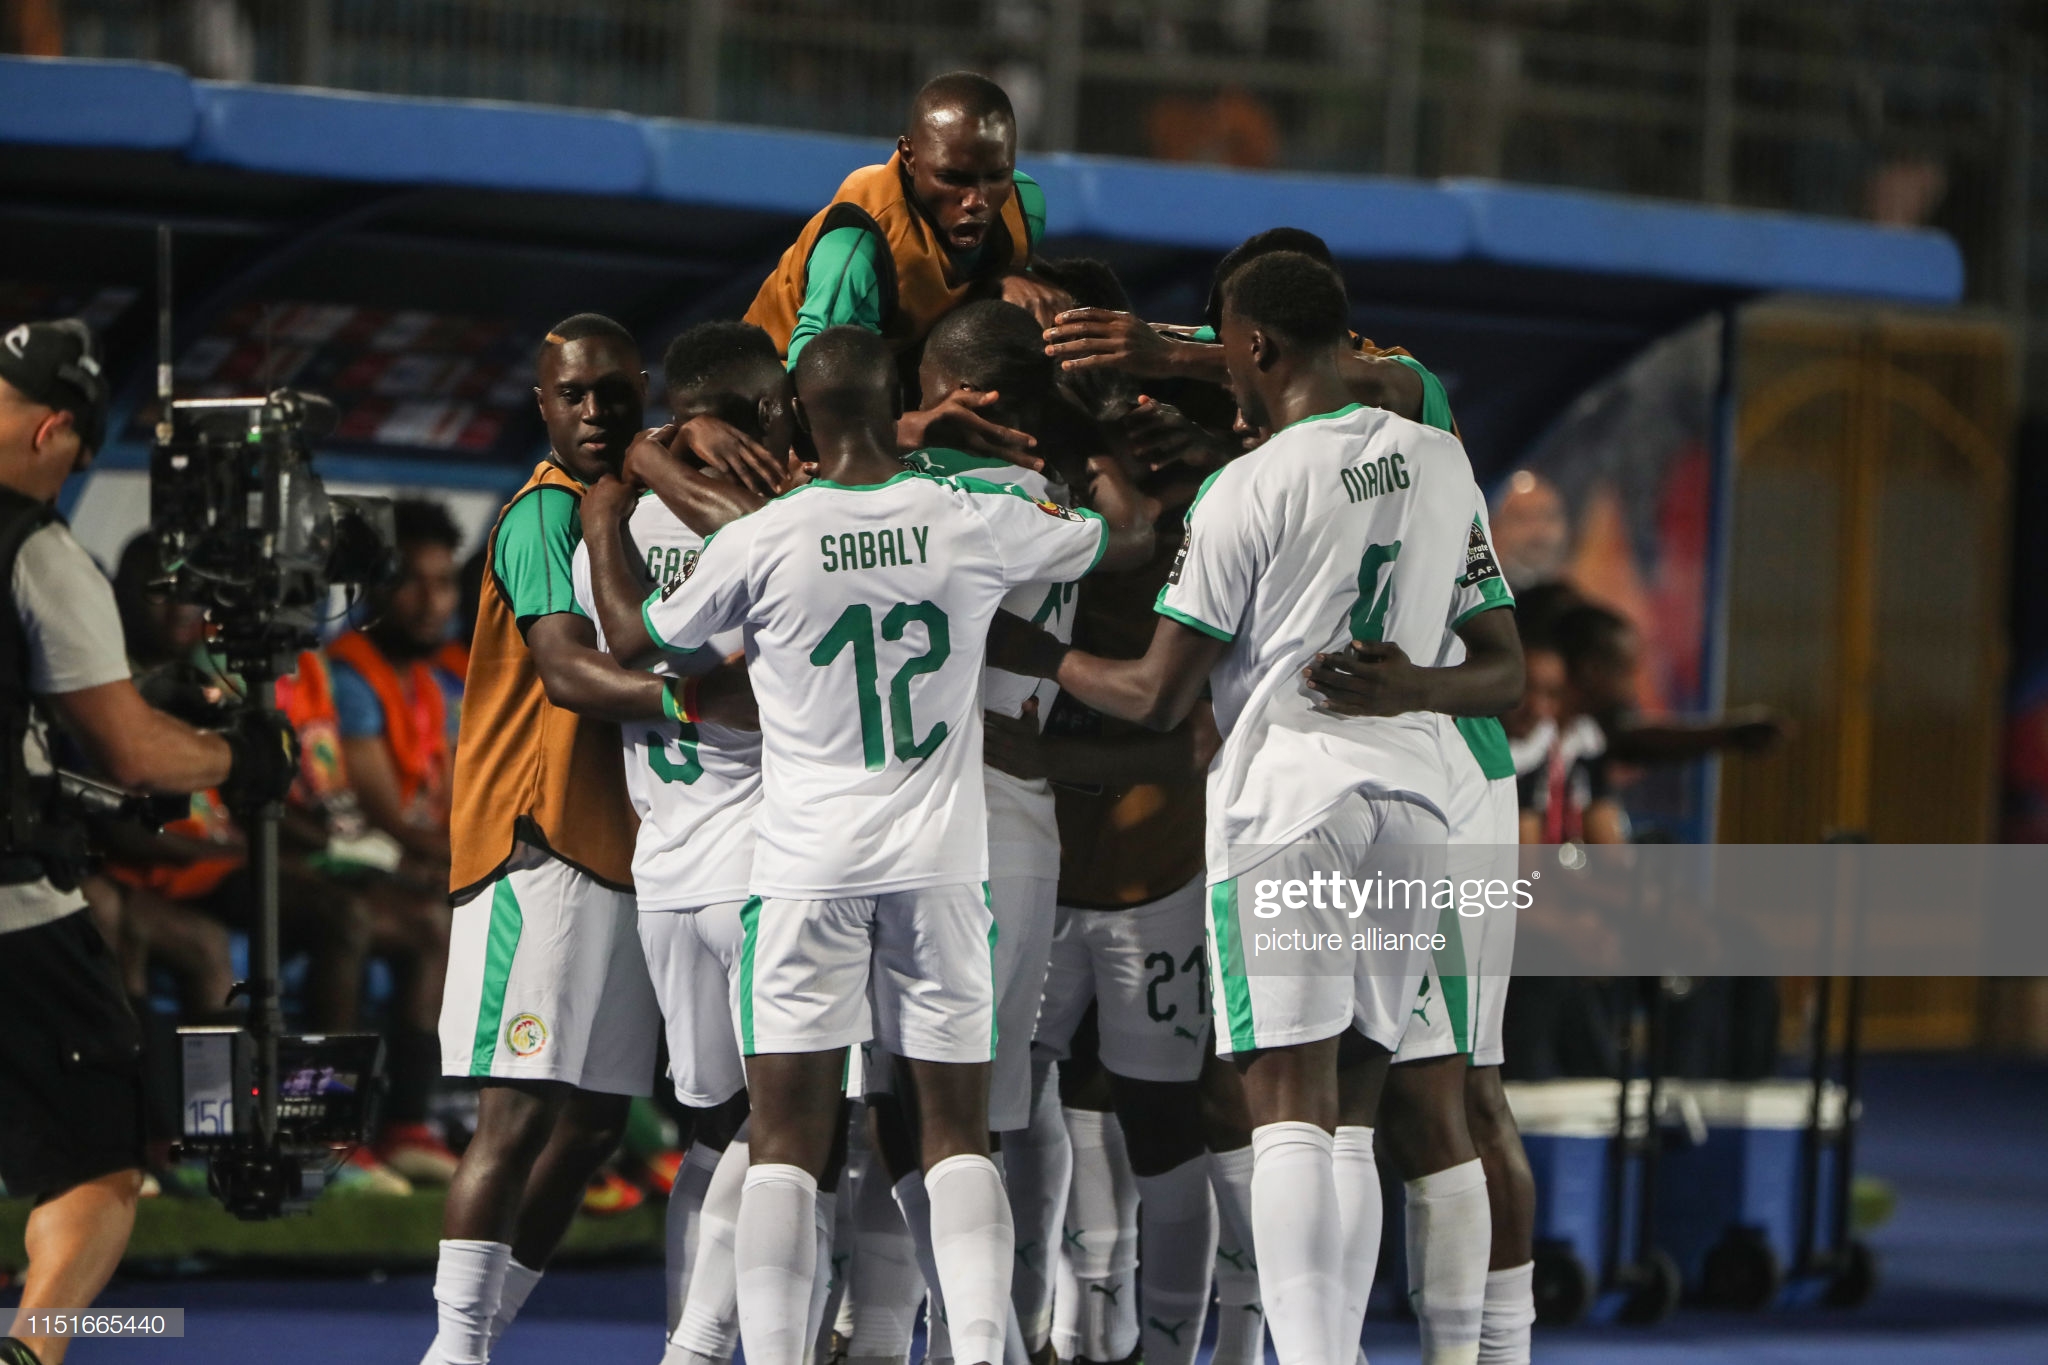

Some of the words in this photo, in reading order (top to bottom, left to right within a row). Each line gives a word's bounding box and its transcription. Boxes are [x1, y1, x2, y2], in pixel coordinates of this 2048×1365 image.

[1341, 453, 1410, 503] NIANG
[820, 525, 929, 572] SABALY
[1467, 566, 1493, 580] CAF
[809, 600, 951, 772] 12
[1144, 945, 1206, 1023] 21
